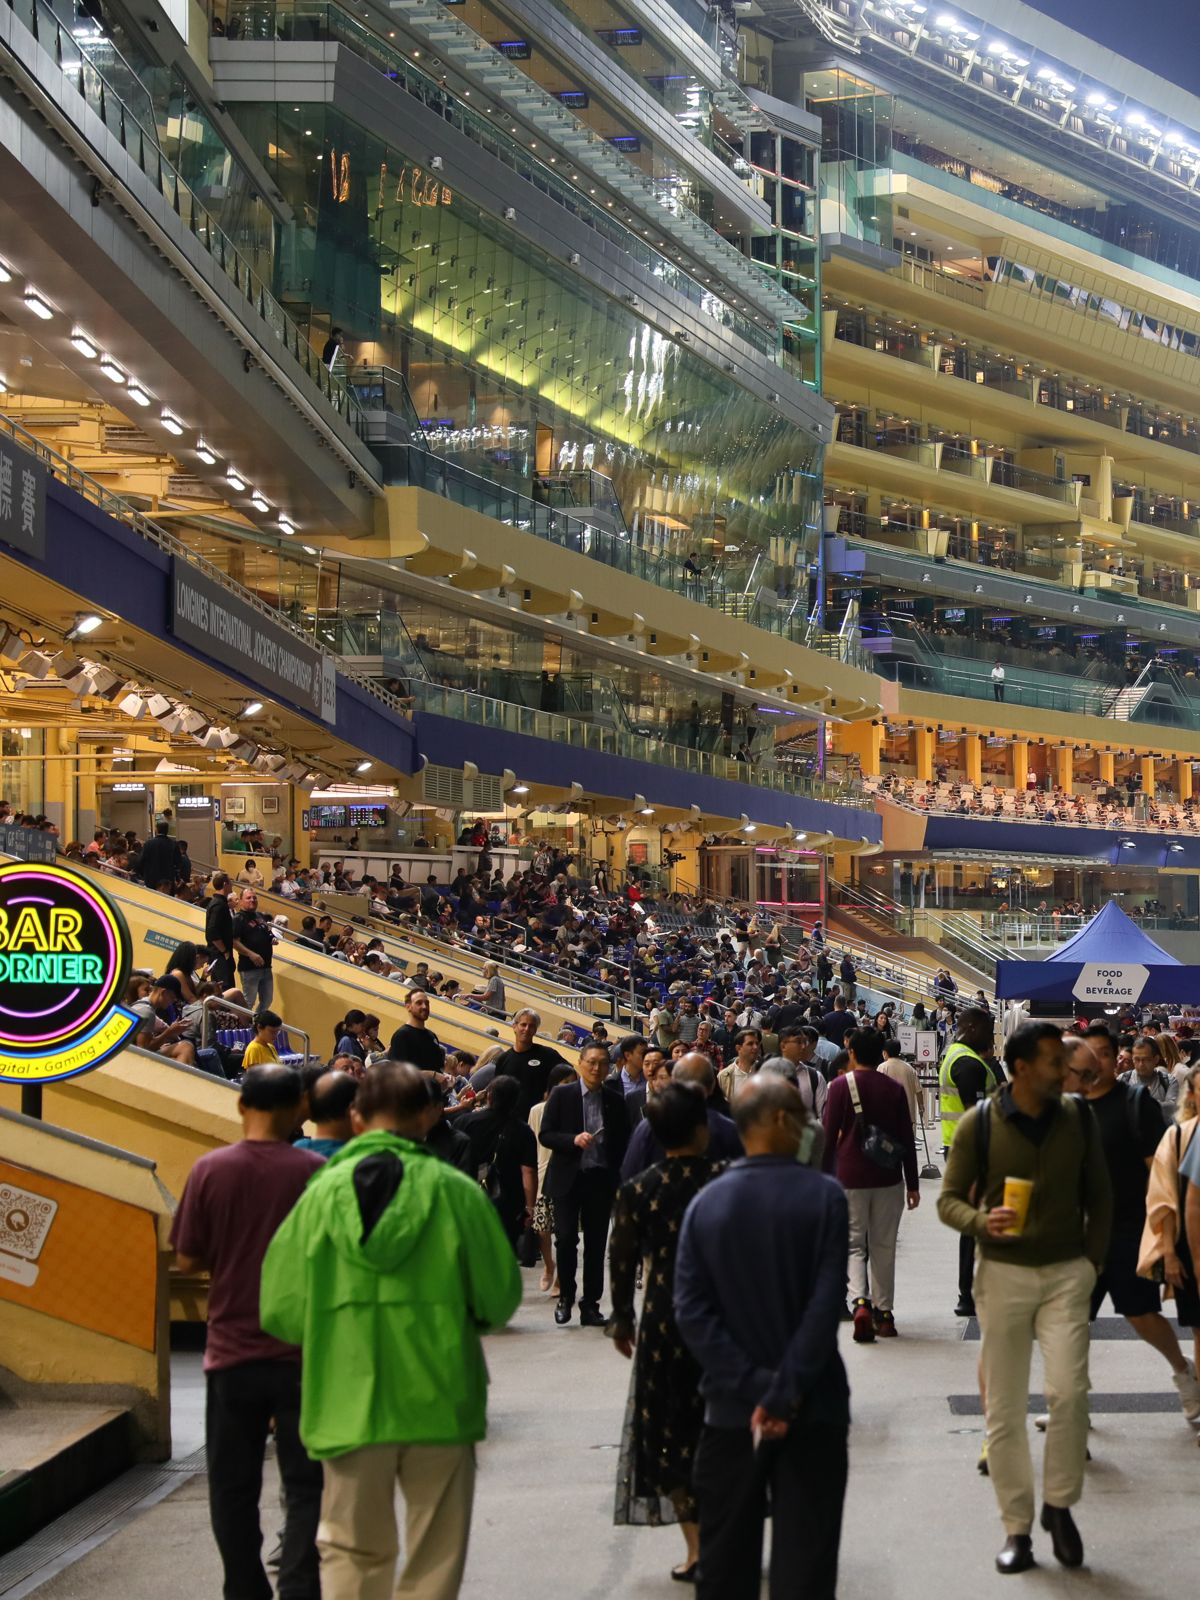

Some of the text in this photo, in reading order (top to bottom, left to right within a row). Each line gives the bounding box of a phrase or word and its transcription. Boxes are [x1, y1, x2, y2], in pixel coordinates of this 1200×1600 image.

[176, 579, 209, 632] LONGINES
[209, 601, 253, 658] INTERNATIONAL
[277, 647, 312, 693] CHAMPIONSHIP
[1097, 970, 1123, 978] FOOD
[1085, 986, 1133, 996] BEVERAGE
[44, 1045, 96, 1072] Gaming
[104, 1019, 125, 1041] Fun
